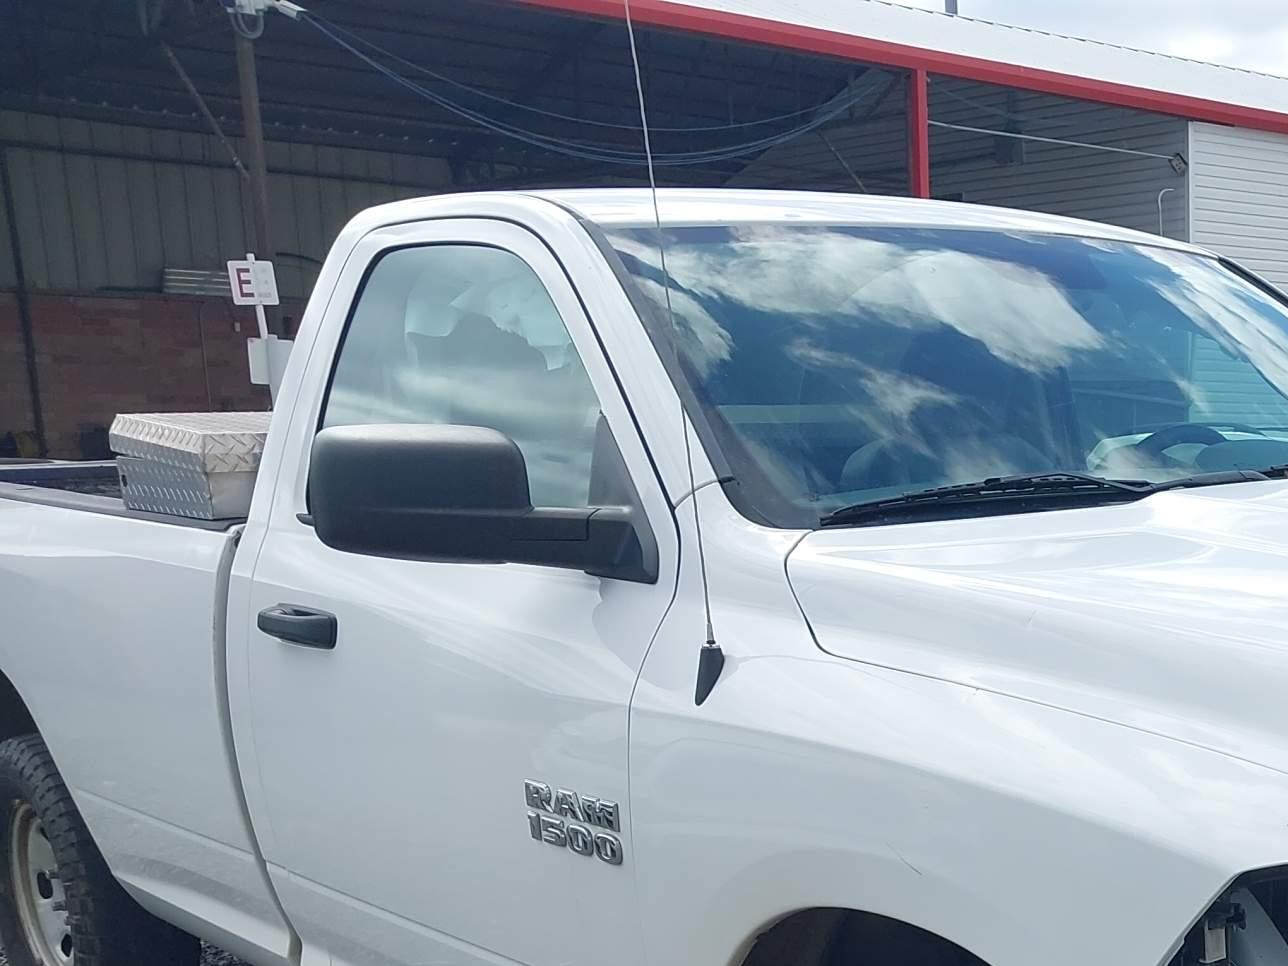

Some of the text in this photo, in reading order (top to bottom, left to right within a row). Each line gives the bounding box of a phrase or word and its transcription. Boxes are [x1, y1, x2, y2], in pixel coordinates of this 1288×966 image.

[235, 267, 255, 298] E
[524, 778, 620, 833] RAM
[527, 810, 623, 866] 1500
